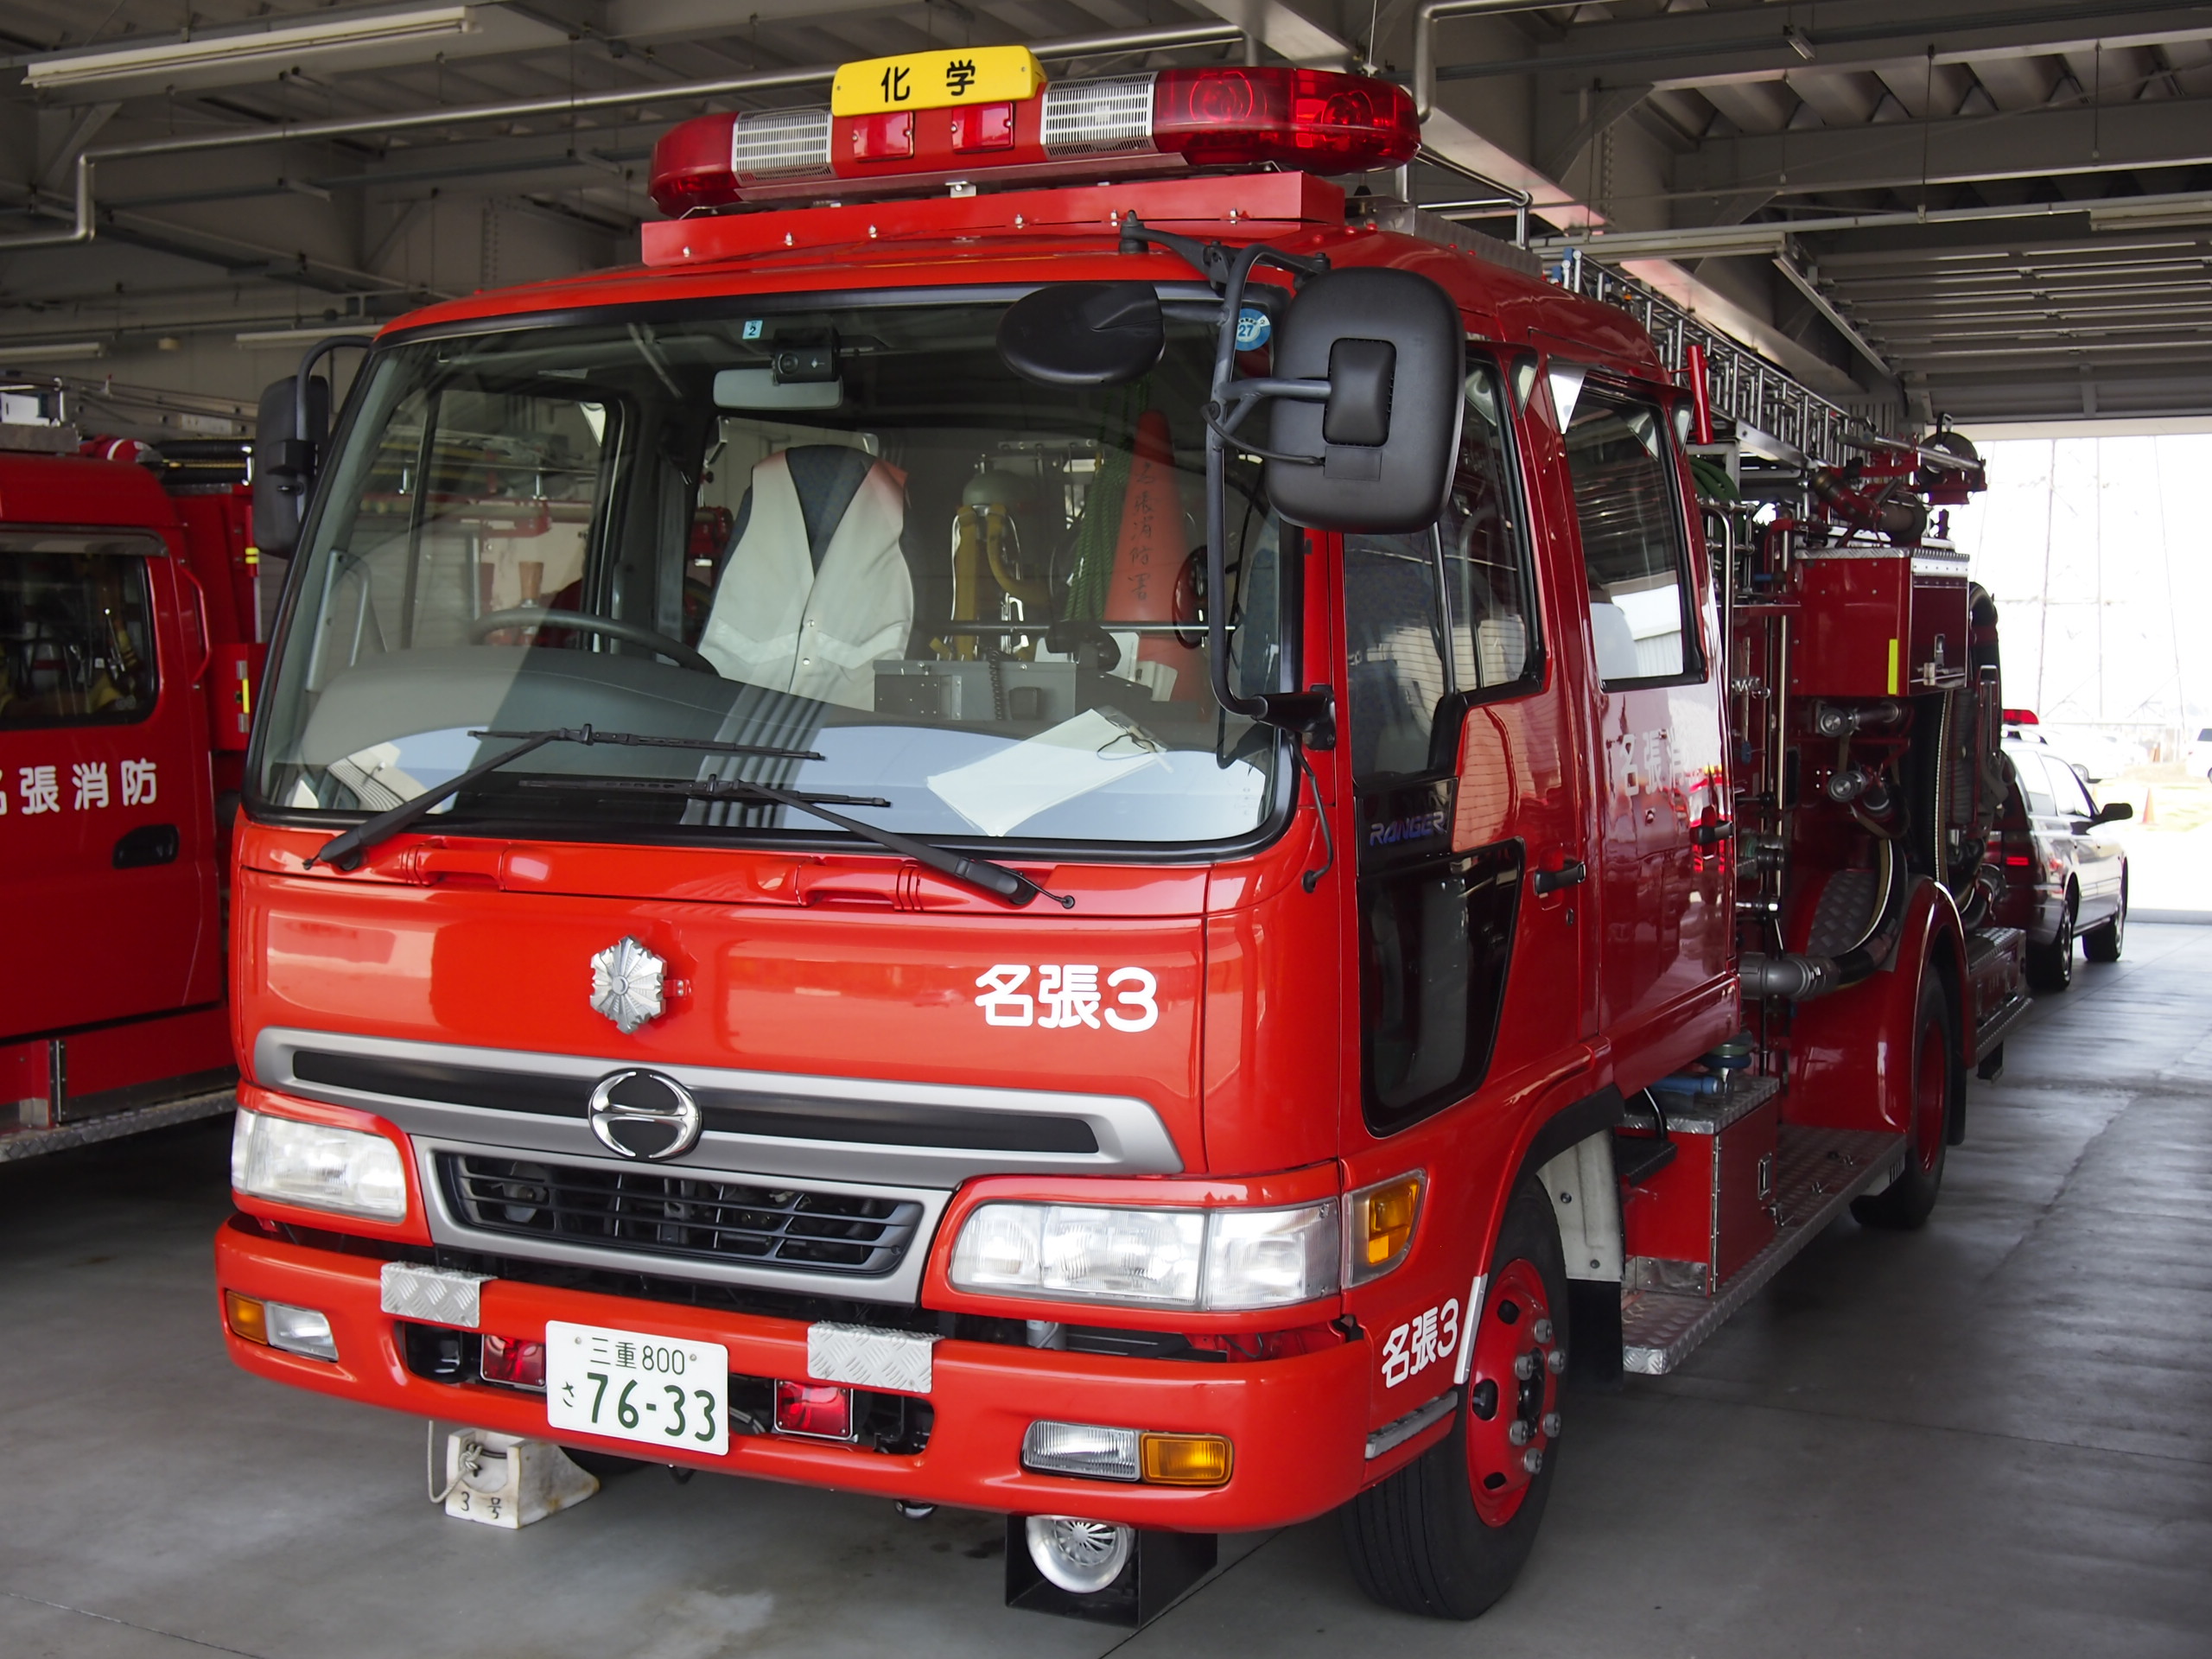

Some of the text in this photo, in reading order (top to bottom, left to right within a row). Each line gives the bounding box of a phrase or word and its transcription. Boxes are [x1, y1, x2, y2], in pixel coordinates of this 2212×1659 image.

[880, 59, 976, 103] 化学
[748, 325, 757, 336] 2
[1237, 324, 1255, 338] 27
[1370, 811, 1445, 846] RANGER
[975, 963, 1159, 1033] 名張3
[1381, 1298, 1459, 1389] 名張3
[561, 1371, 716, 1442] さ 76-33
